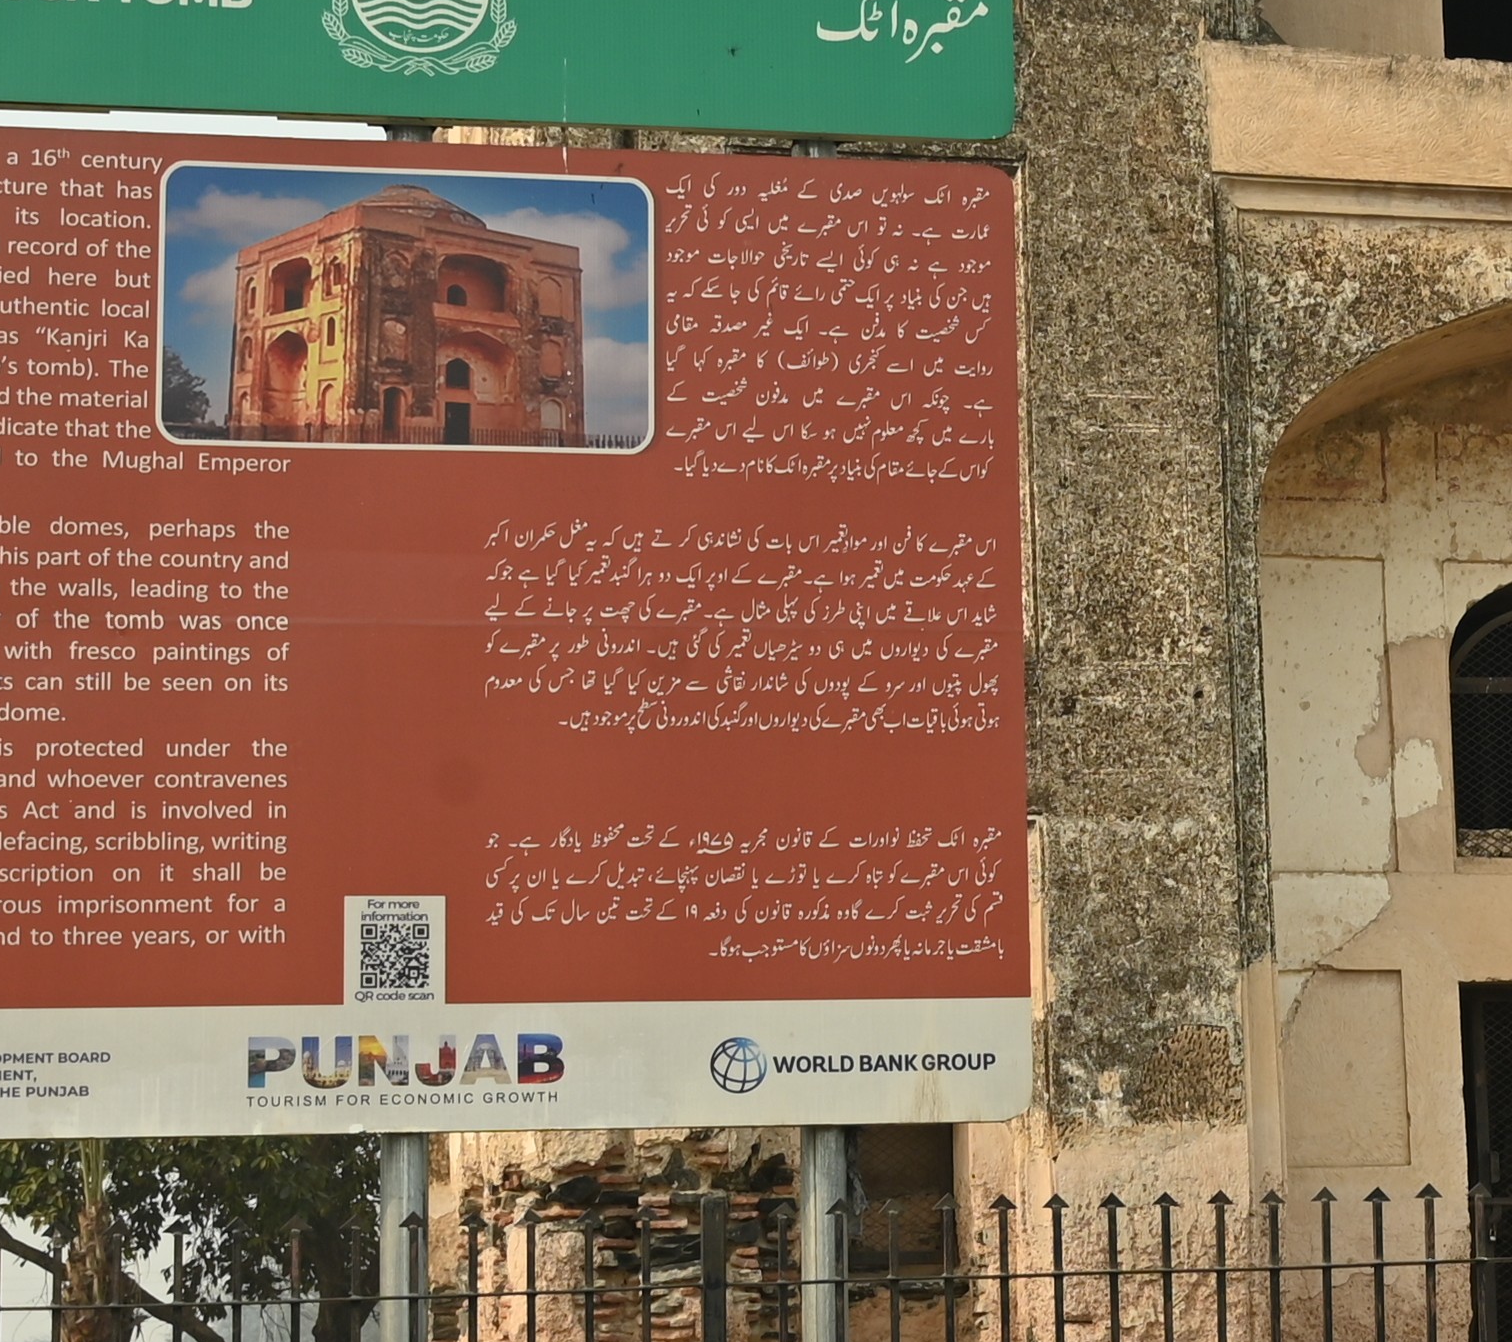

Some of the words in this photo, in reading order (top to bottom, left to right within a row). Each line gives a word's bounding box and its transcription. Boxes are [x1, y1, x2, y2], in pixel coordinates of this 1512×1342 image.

[6, 151, 19, 165] a
[31, 147, 70, 167] 16th
[81, 153, 163, 175] century
[59, 178, 105, 198] that
[116, 179, 153, 200] has
[15, 206, 40, 225] its
[60, 207, 151, 229] location.
[8, 237, 78, 256] record
[86, 238, 109, 257] of
[115, 239, 152, 259] the
[48, 266, 97, 287] here
[115, 268, 151, 289] but
[101, 298, 150, 319] local
[124, 330, 149, 349] Ka
[26, 357, 99, 381] tomb).
[108, 359, 149, 379] The
[16, 386, 53, 406] the
[59, 389, 148, 409] material
[64, 418, 109, 438] that
[115, 419, 152, 439] the
[15, 449, 38, 467] to
[51, 448, 88, 468] the
[103, 450, 184, 474] Mughal
[198, 452, 291, 476] Emperor
[367, 899, 385, 909] For
[388, 901, 420, 909] more
[361, 910, 429, 922] information
[354, 990, 374, 1003] QR
[375, 990, 406, 1001] code
[408, 992, 435, 1001] scan
[57, 1051, 111, 1064] BOARD
[247, 1032, 566, 1089] PUNJAB
[772, 1054, 855, 1074] WORLD
[859, 1053, 918, 1073] BANK
[921, 1052, 996, 1072] GROUP
[25, 1085, 90, 1098] PUNJAB
[246, 1095, 327, 1108] TOURISM
[335, 1094, 370, 1106] FOR
[379, 1092, 474, 1106] ECONOMIC
[482, 1091, 558, 1104] GROWTH
